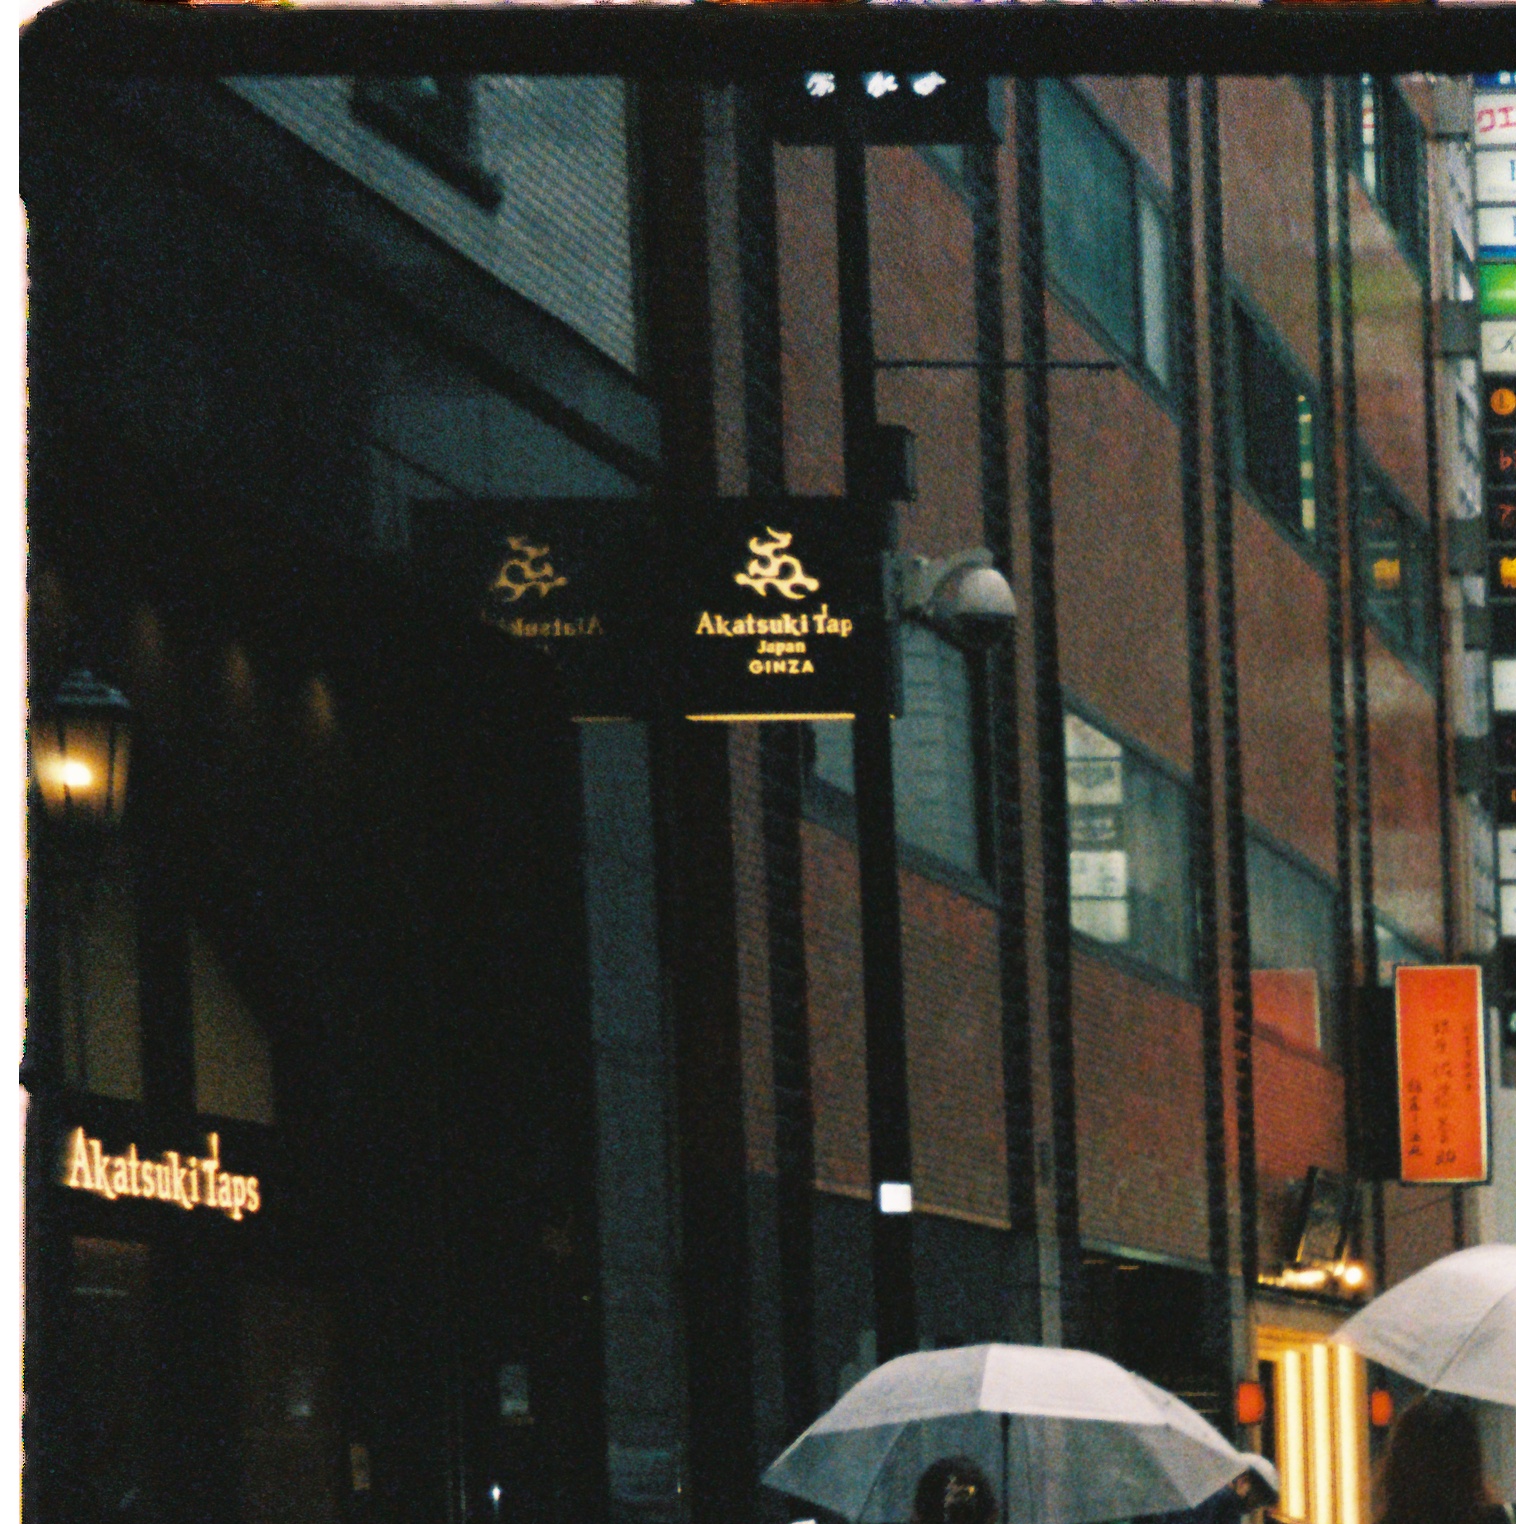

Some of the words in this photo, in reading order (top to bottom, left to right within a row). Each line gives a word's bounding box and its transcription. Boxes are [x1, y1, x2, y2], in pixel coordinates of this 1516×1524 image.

[695, 611, 809, 638] Akatsuki
[757, 640, 806, 655] Japan
[748, 659, 815, 675] GINZA
[64, 1125, 200, 1211] Akatsuki
[201, 1131, 262, 1222] Taps
